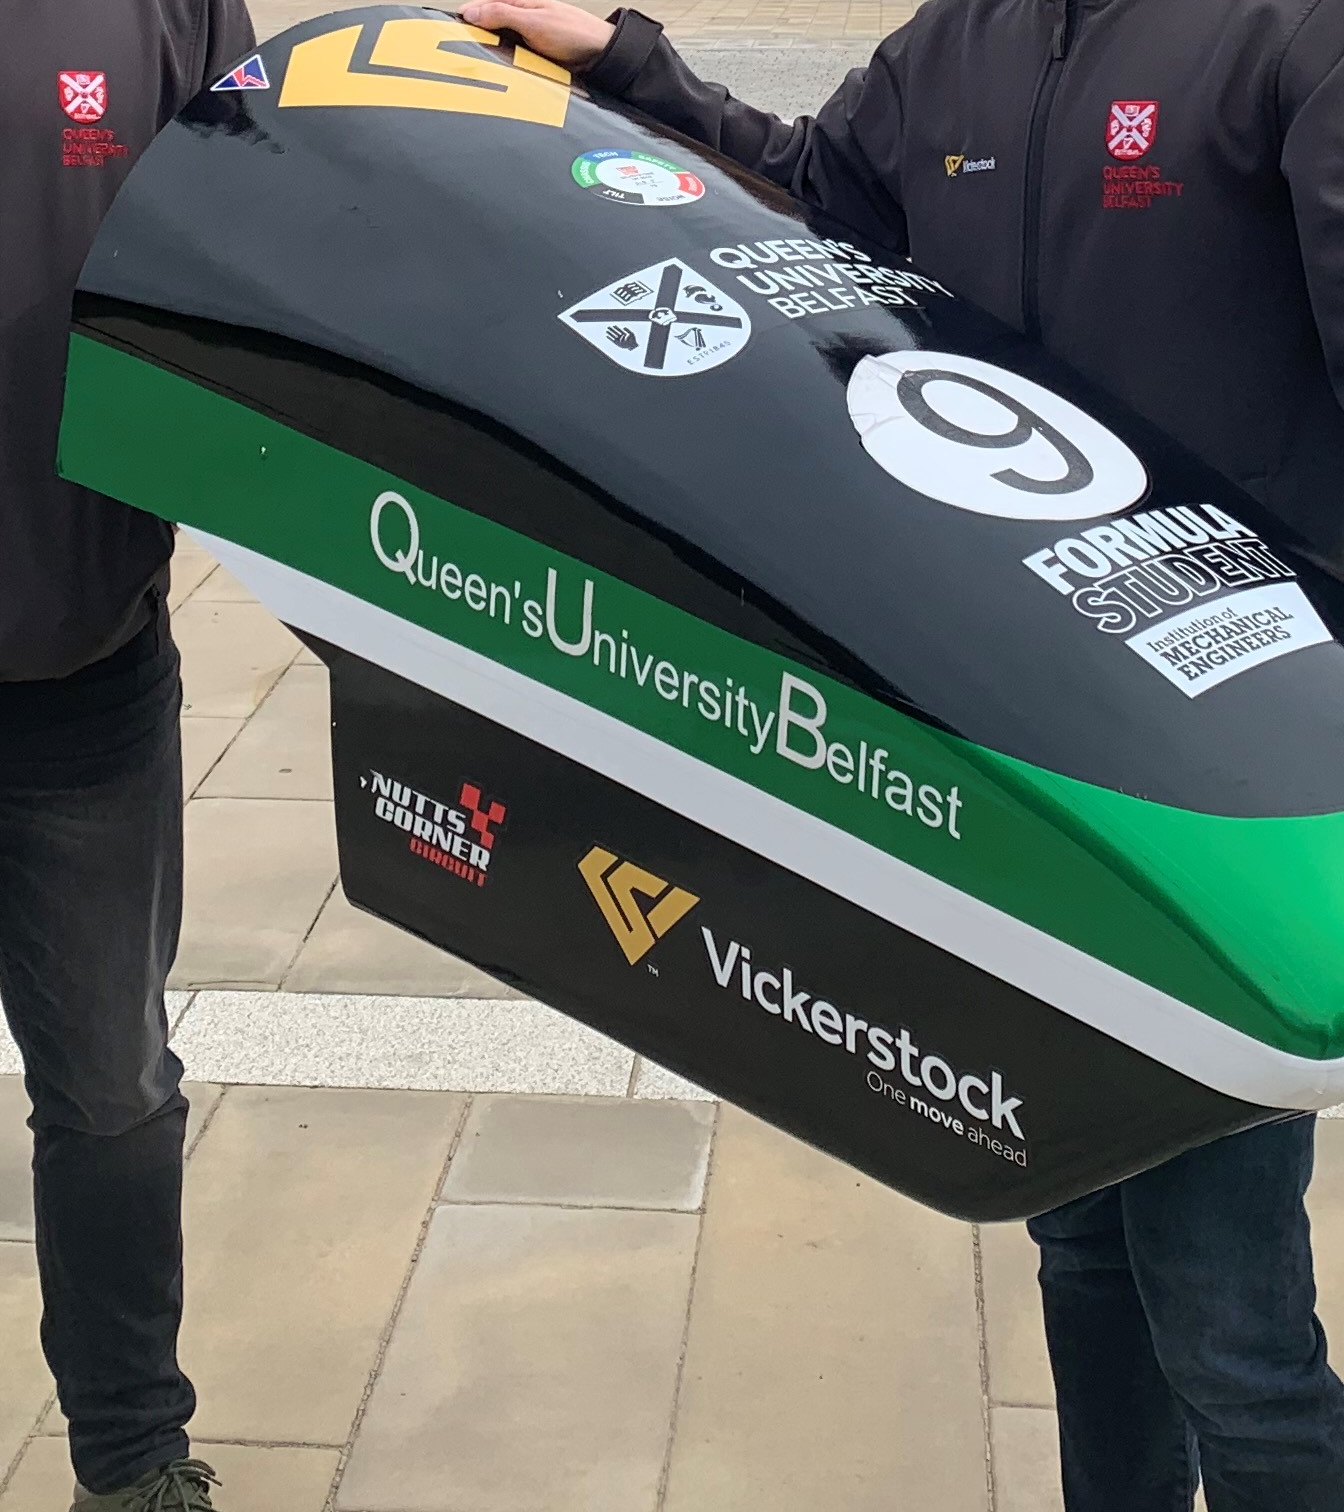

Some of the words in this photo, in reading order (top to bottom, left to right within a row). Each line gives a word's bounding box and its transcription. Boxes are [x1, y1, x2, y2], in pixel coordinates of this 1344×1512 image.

[603, 189, 625, 199] TILT
[1102, 165, 1160, 180] QUEEN'S
[1102, 181, 1184, 197] UNIVERSITY
[1102, 195, 1152, 208] BELFAST
[710, 239, 871, 269] QUEEN'S
[736, 264, 955, 299] UNIVERSITY
[767, 287, 919, 320] BELFAST
[897, 369, 1094, 495] 9
[1022, 503, 1258, 595] FORMULA
[1072, 539, 1297, 633] STUDENT
[1146, 615, 1223, 652] Institution
[1222, 607, 1239, 619] of
[1159, 607, 1294, 666] MECHANICAL
[1177, 625, 1292, 681] ENGINEERS
[370, 769, 466, 834] NUTTS
[375, 796, 491, 871] CORNER
[410, 838, 487, 887] CIRCUIT
[701, 926, 1026, 1141] Vickerstock
[866, 1071, 906, 1104] One
[909, 1096, 964, 1136] move
[967, 1126, 1027, 1167] ahead
